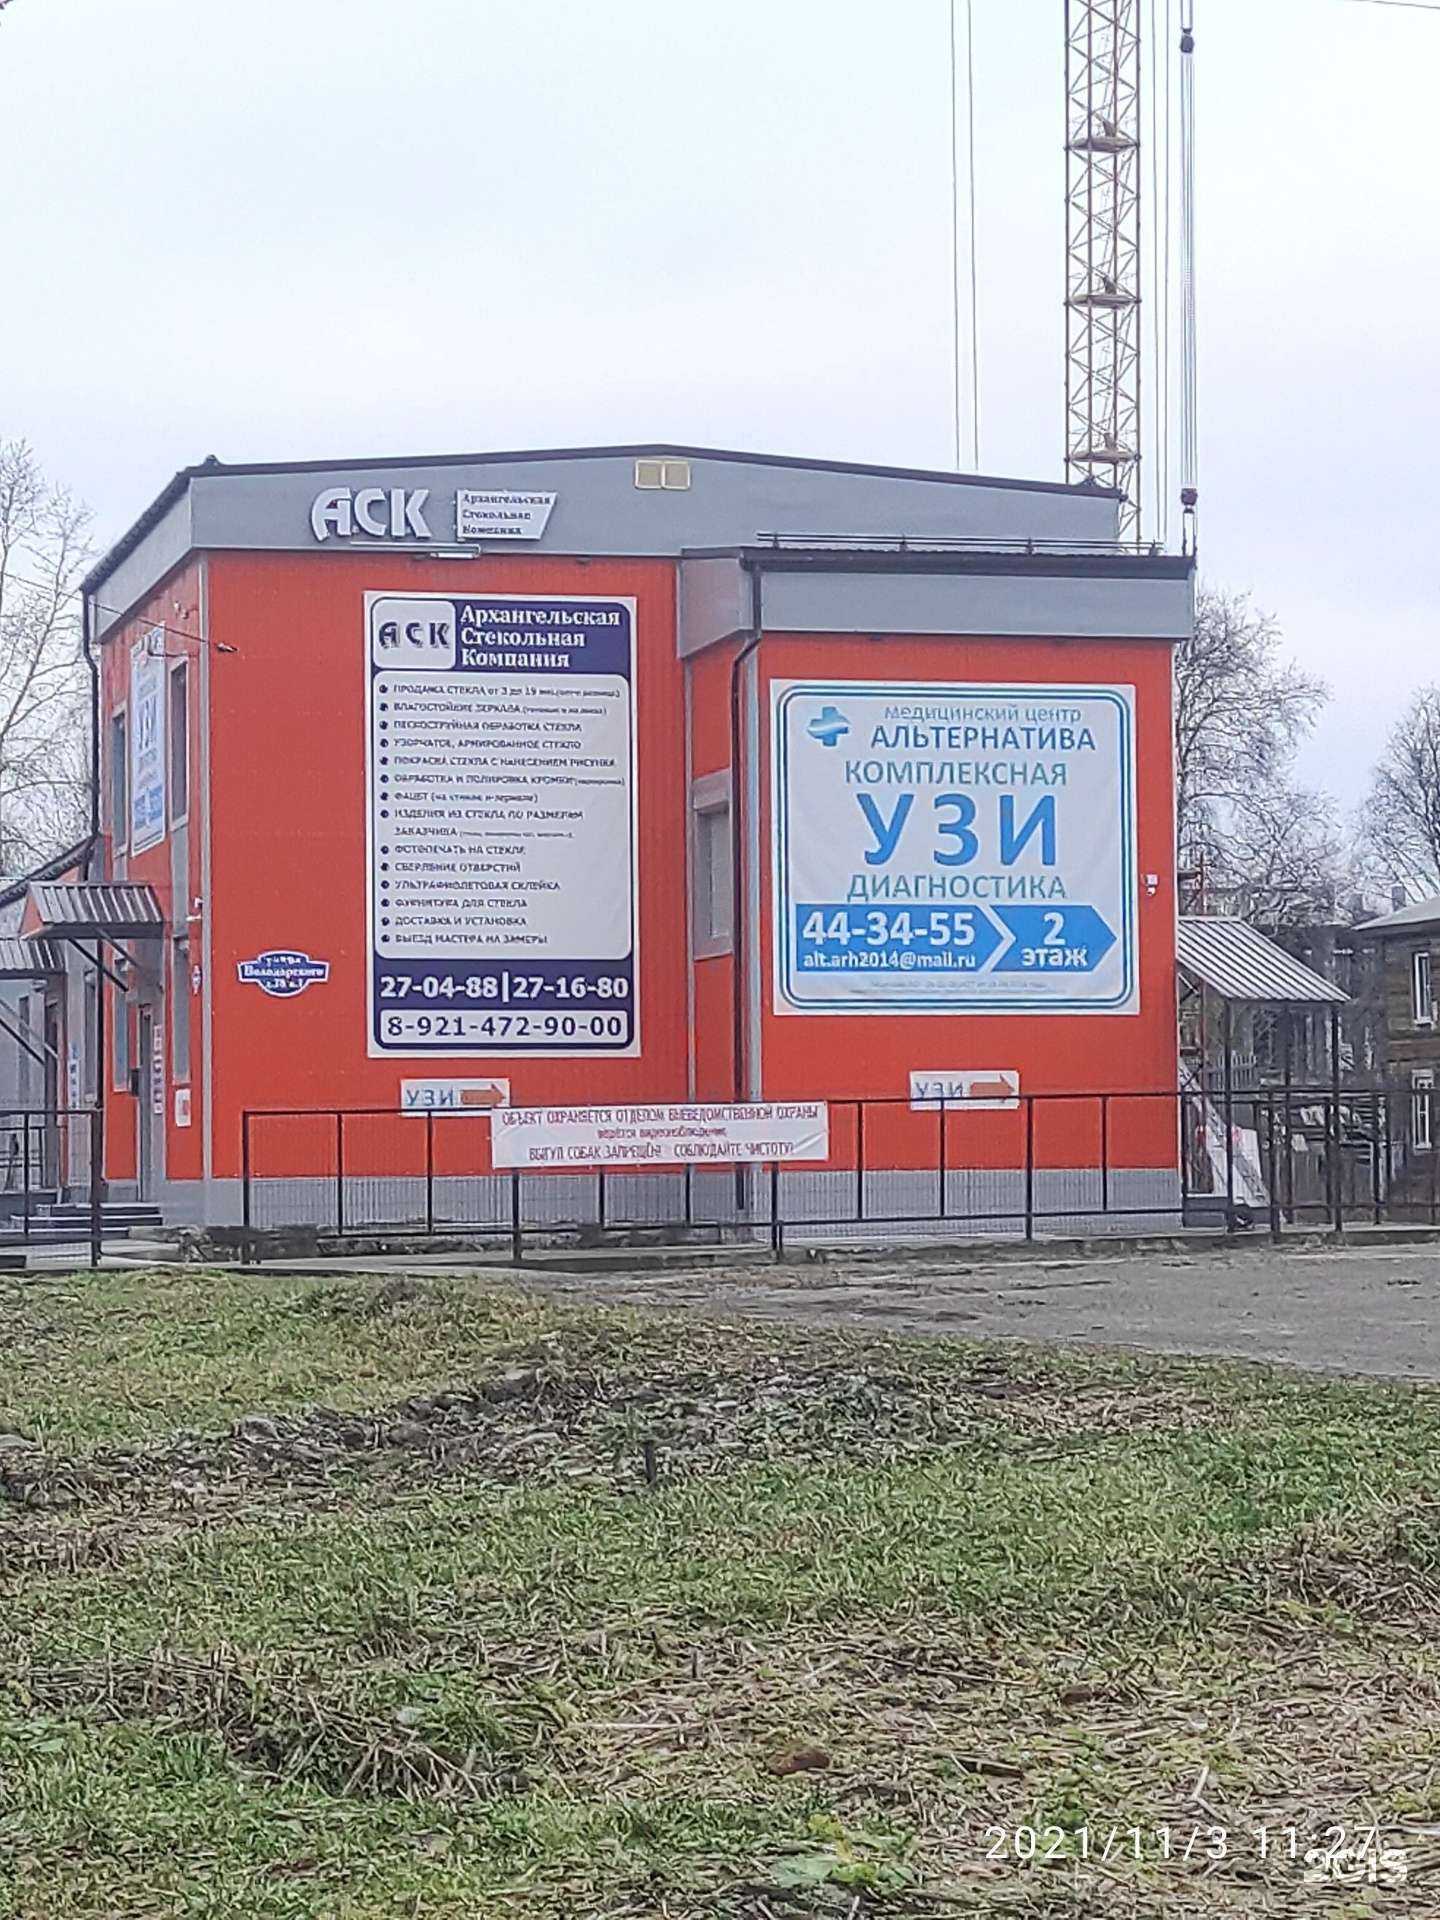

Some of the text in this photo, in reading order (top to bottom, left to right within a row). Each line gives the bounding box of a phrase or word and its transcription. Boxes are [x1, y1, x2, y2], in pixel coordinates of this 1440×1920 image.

[311, 486, 433, 542] АСК
[460, 604, 620, 627] Архангельская
[379, 621, 450, 649] АСК
[460, 627, 585, 648] Стекольная
[461, 648, 570, 669] Компания
[1025, 706, 1081, 723] центр
[871, 726, 1096, 751] АЛЬТЕРНАТИВА
[845, 760, 1067, 786] КОМПЛЕКСНАЯ
[856, 793, 1055, 867] УЗИ
[846, 875, 1067, 904] ДИАГНОСТИКА
[802, 912, 975, 946] 44-34-55
[1043, 912, 1065, 946] 2
[1022, 947, 1087, 968] этаж
[387, 1016, 622, 1036] 8-921-472-90-00
[406, 1088, 454, 1107] УЗИ
[915, 1081, 964, 1099] УЗИ
